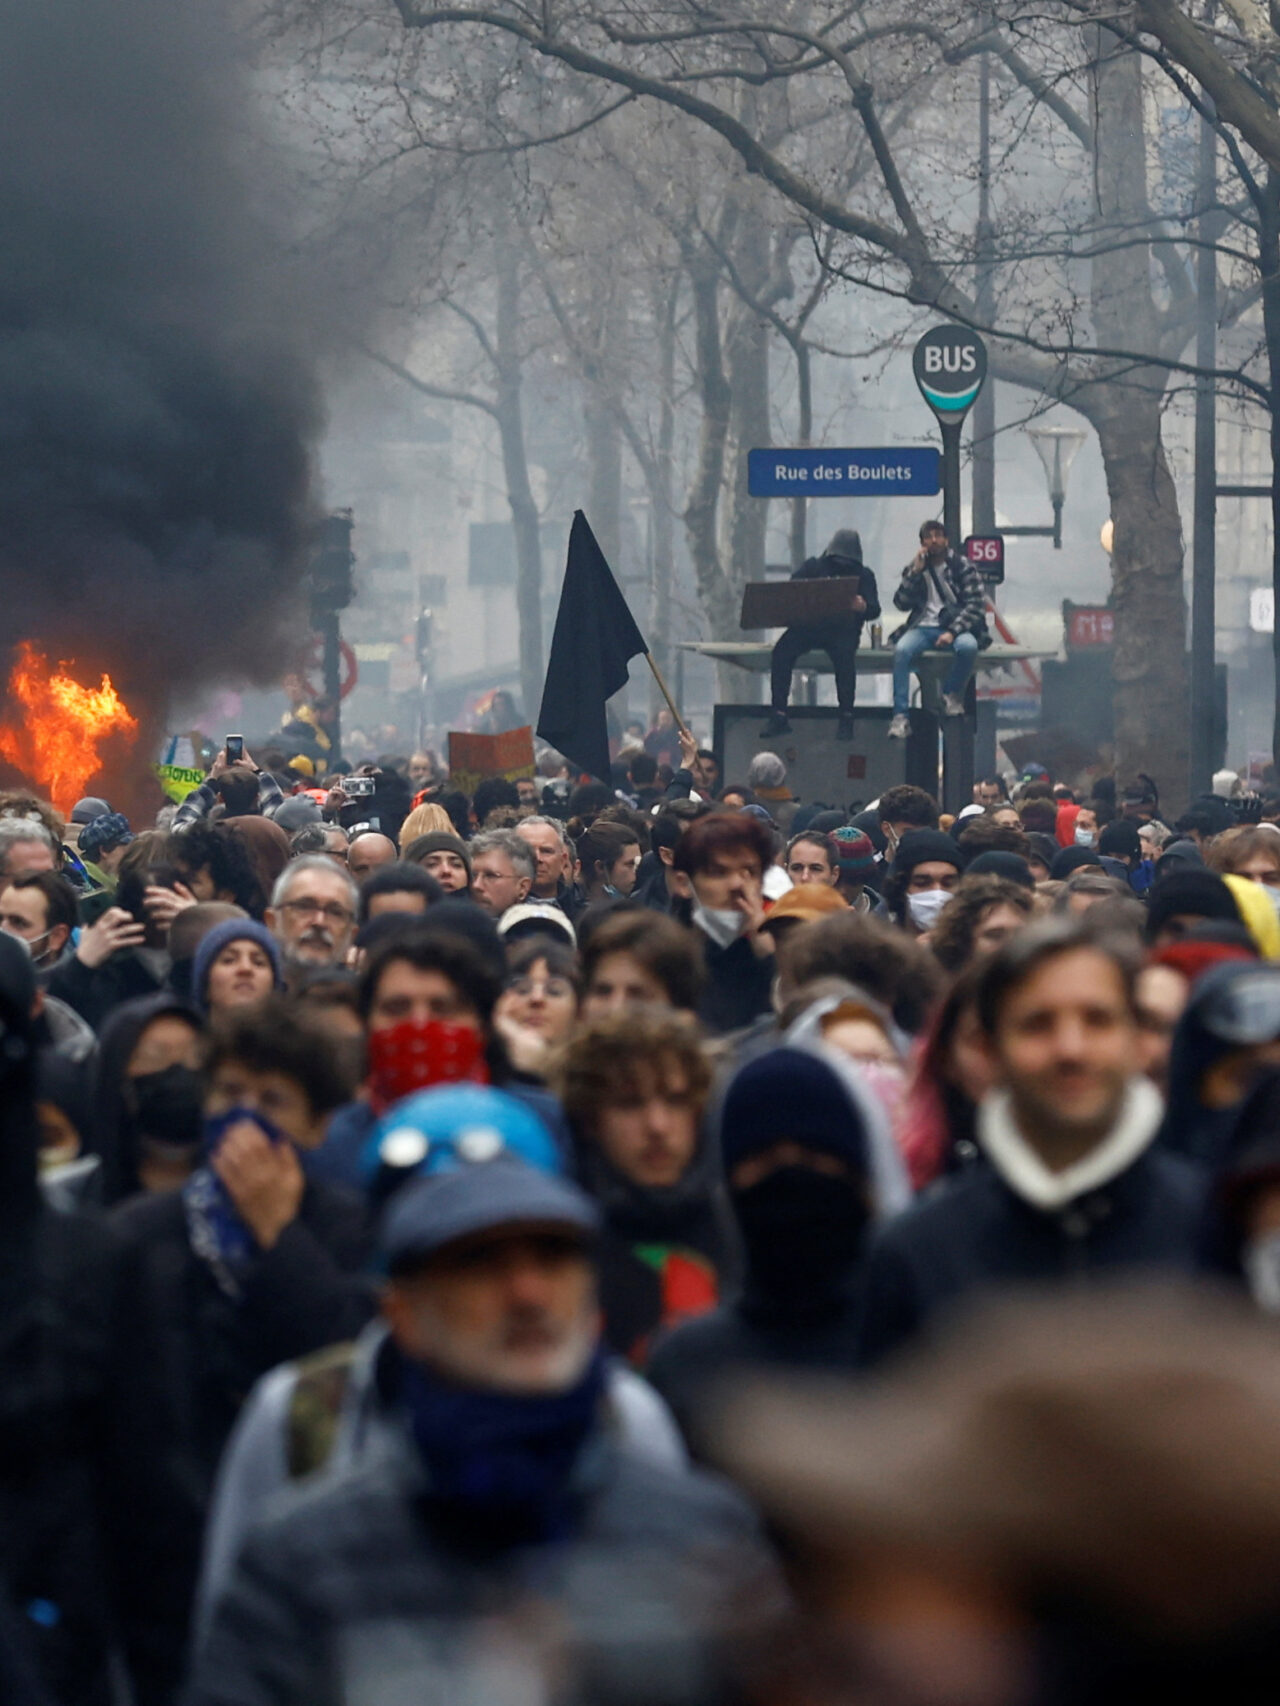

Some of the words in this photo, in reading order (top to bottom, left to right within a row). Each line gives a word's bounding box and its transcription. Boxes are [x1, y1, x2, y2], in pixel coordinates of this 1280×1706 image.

[925, 344, 977, 373] BUS
[775, 464, 808, 480] Rue
[813, 464, 843, 480] des
[848, 464, 912, 480] Boulets
[972, 540, 998, 561] 56
